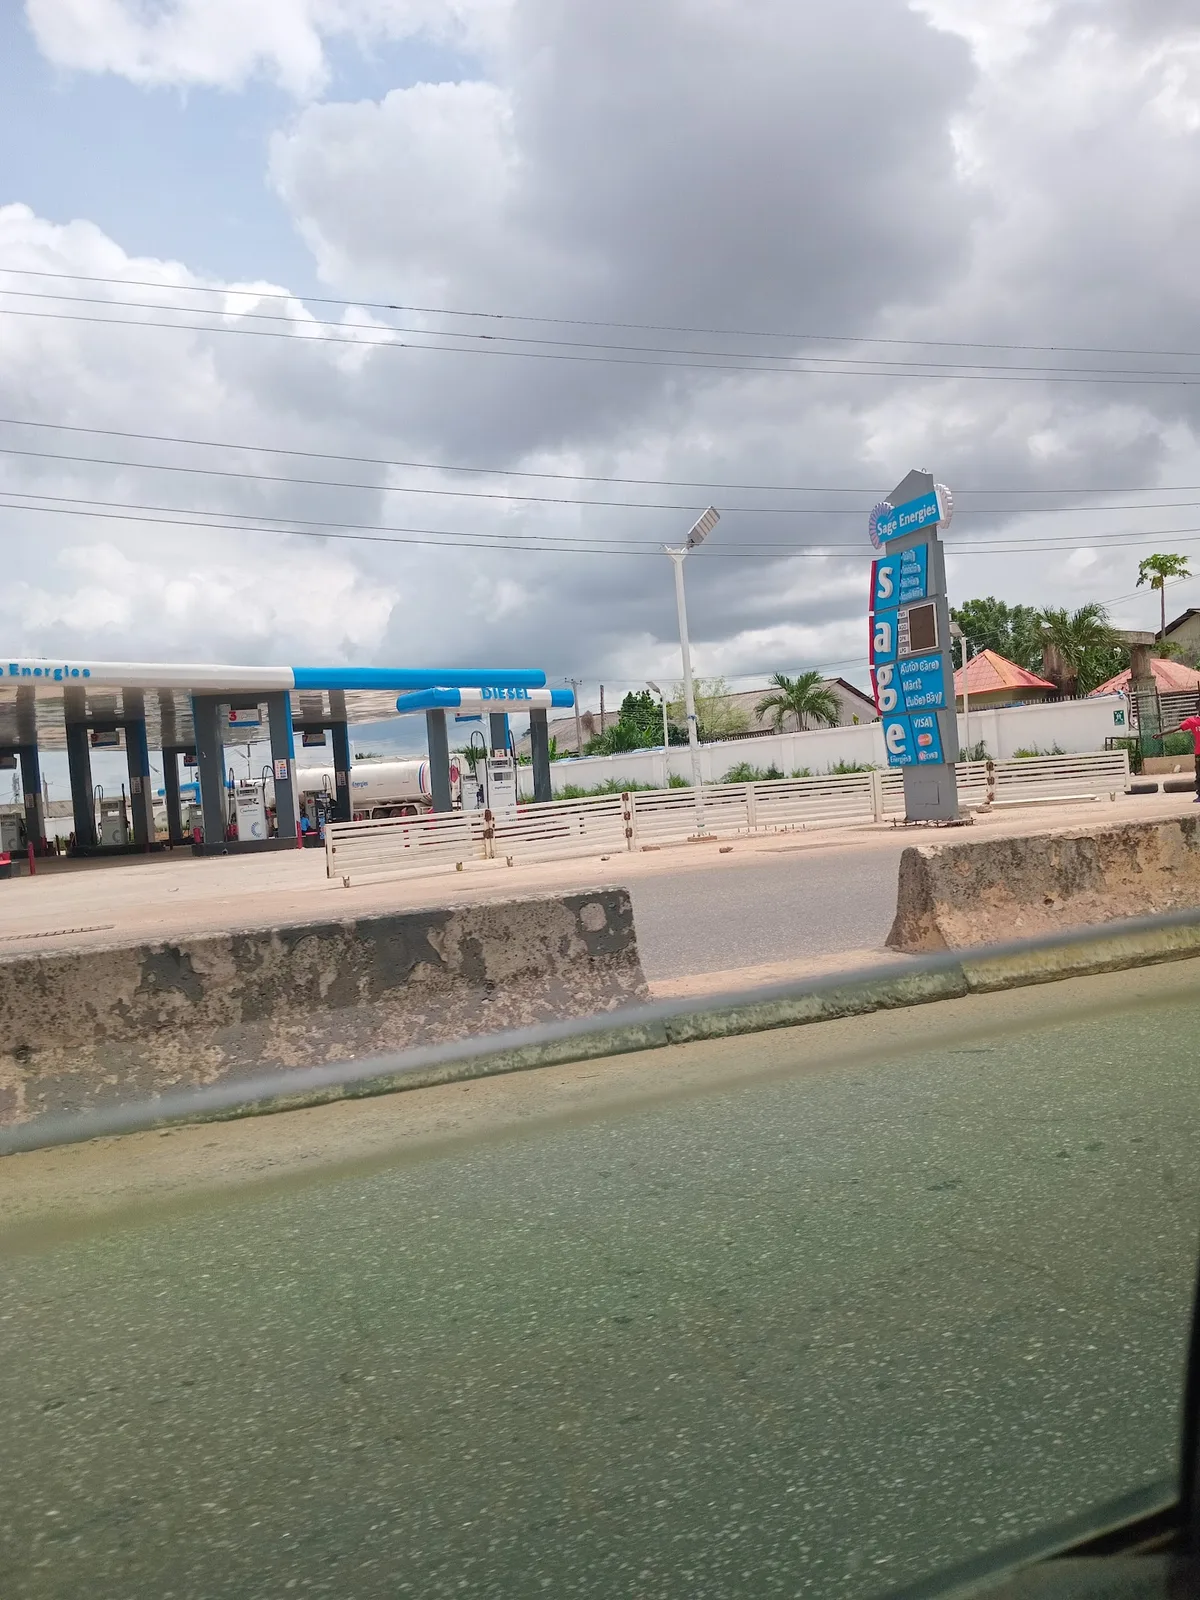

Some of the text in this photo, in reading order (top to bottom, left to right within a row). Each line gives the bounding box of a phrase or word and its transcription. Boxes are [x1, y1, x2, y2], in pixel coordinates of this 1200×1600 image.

[877, 504, 936, 535] Sage Energies
[9, 663, 91, 681] Energies
[900, 660, 939, 675] Auto Care
[902, 678, 922, 691] Mart
[481, 687, 532, 700] DIESEL
[905, 692, 943, 707] Lube Bay
[228, 711, 237, 721] 3
[913, 716, 933, 728] VISA
